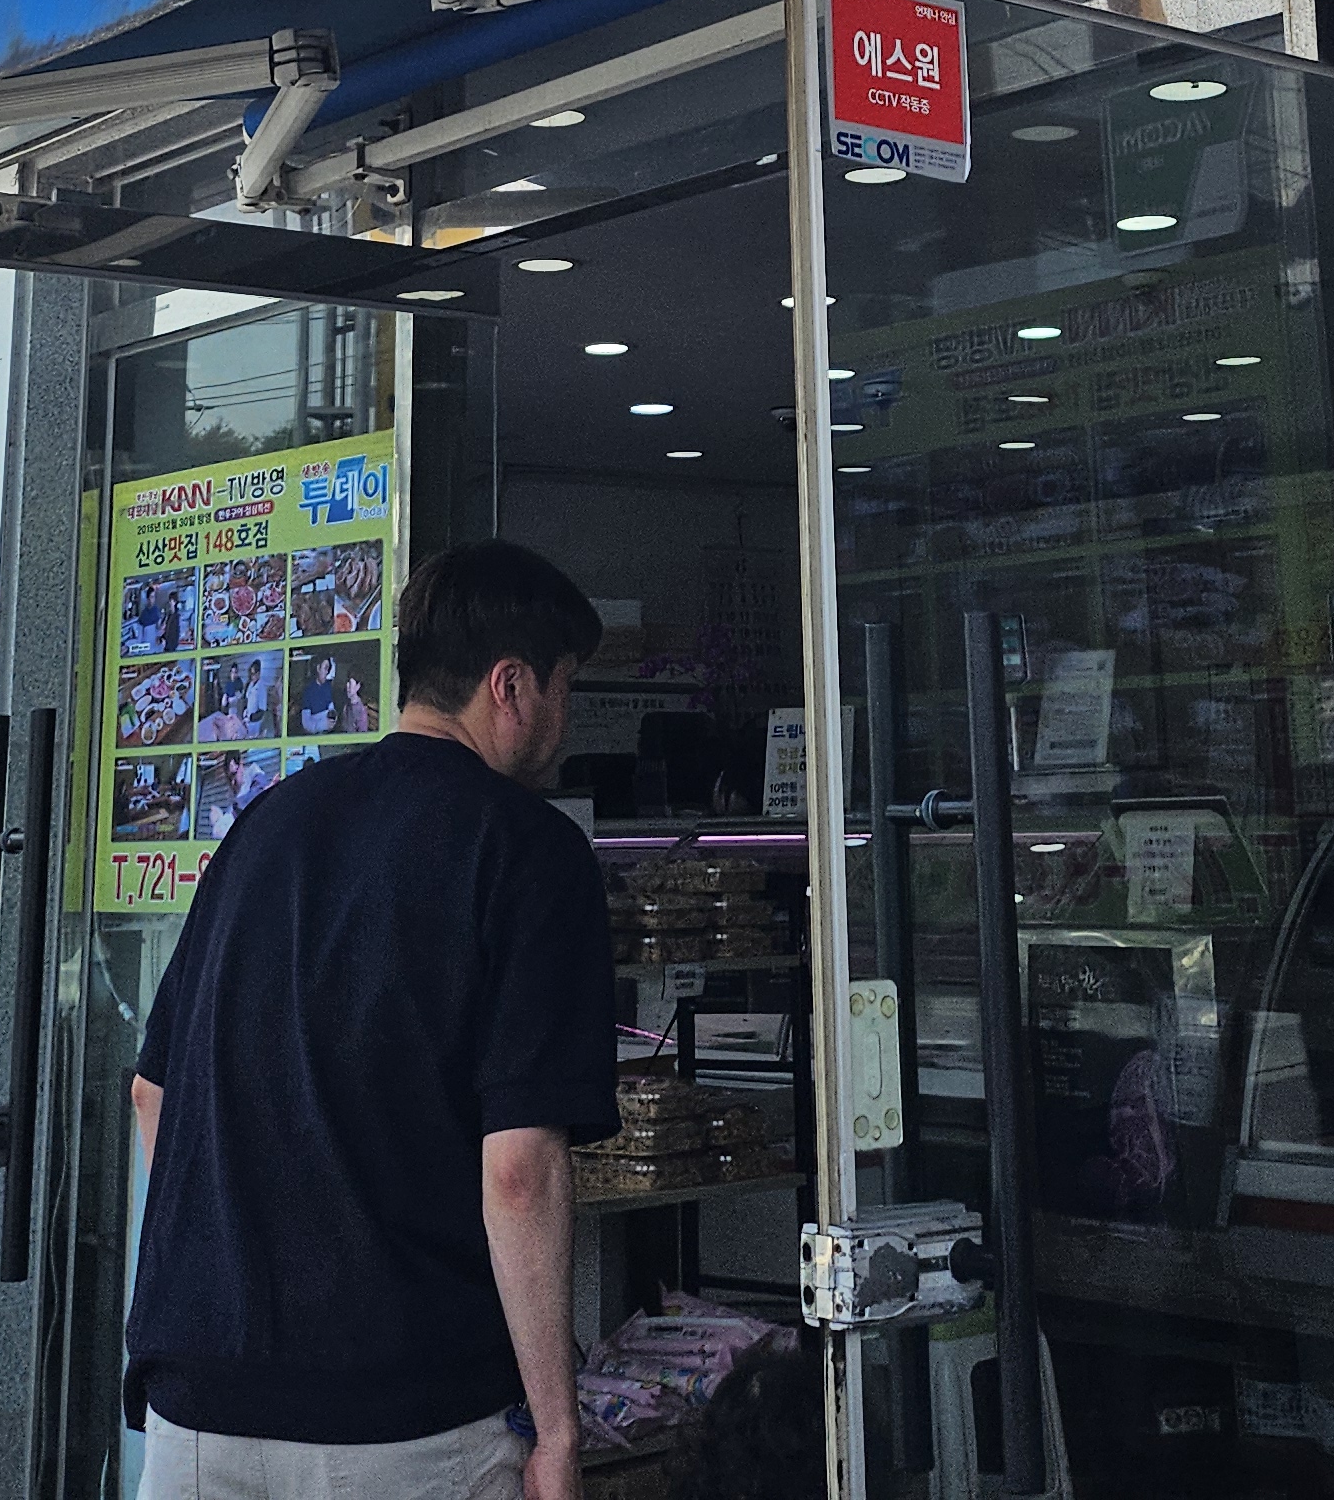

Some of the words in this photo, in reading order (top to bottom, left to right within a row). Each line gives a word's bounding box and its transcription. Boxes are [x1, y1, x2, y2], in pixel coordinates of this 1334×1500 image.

[853, 30, 942, 90] 에스원
[868, 88, 900, 108] CCTV
[900, 93, 931, 115] 작동중
[836, 130, 911, 168] SECOM
[160, 479, 213, 516] KNN
[298, 463, 389, 527] 투데이
[179, 514, 196, 528] 30일
[135, 532, 199, 568] 신상맛집
[204, 519, 270, 555] 148호점
